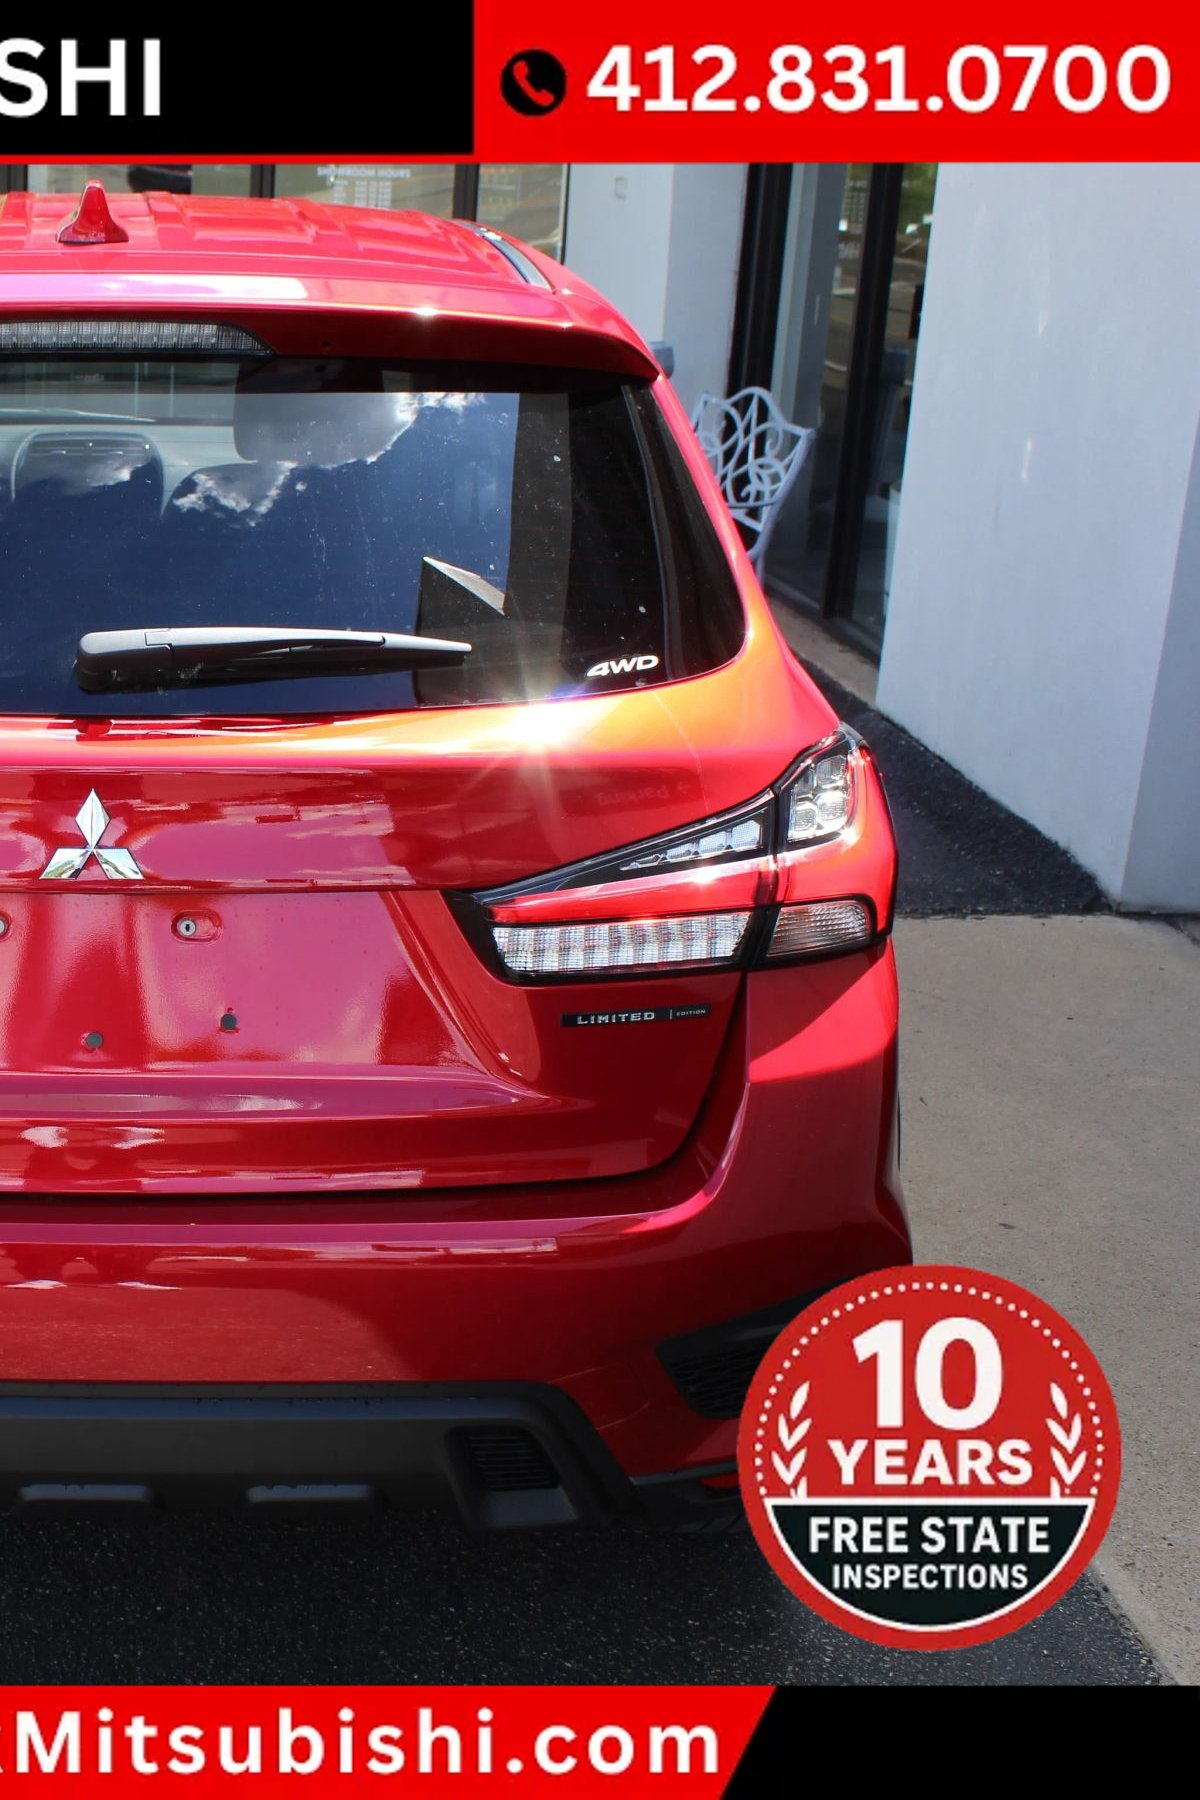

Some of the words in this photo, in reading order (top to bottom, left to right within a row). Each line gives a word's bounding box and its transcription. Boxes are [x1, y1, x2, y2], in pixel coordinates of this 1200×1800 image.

[585, 655, 660, 677] 4WD
[576, 1011, 656, 1026] LIMITED
[676, 1008, 707, 1017] EDITION
